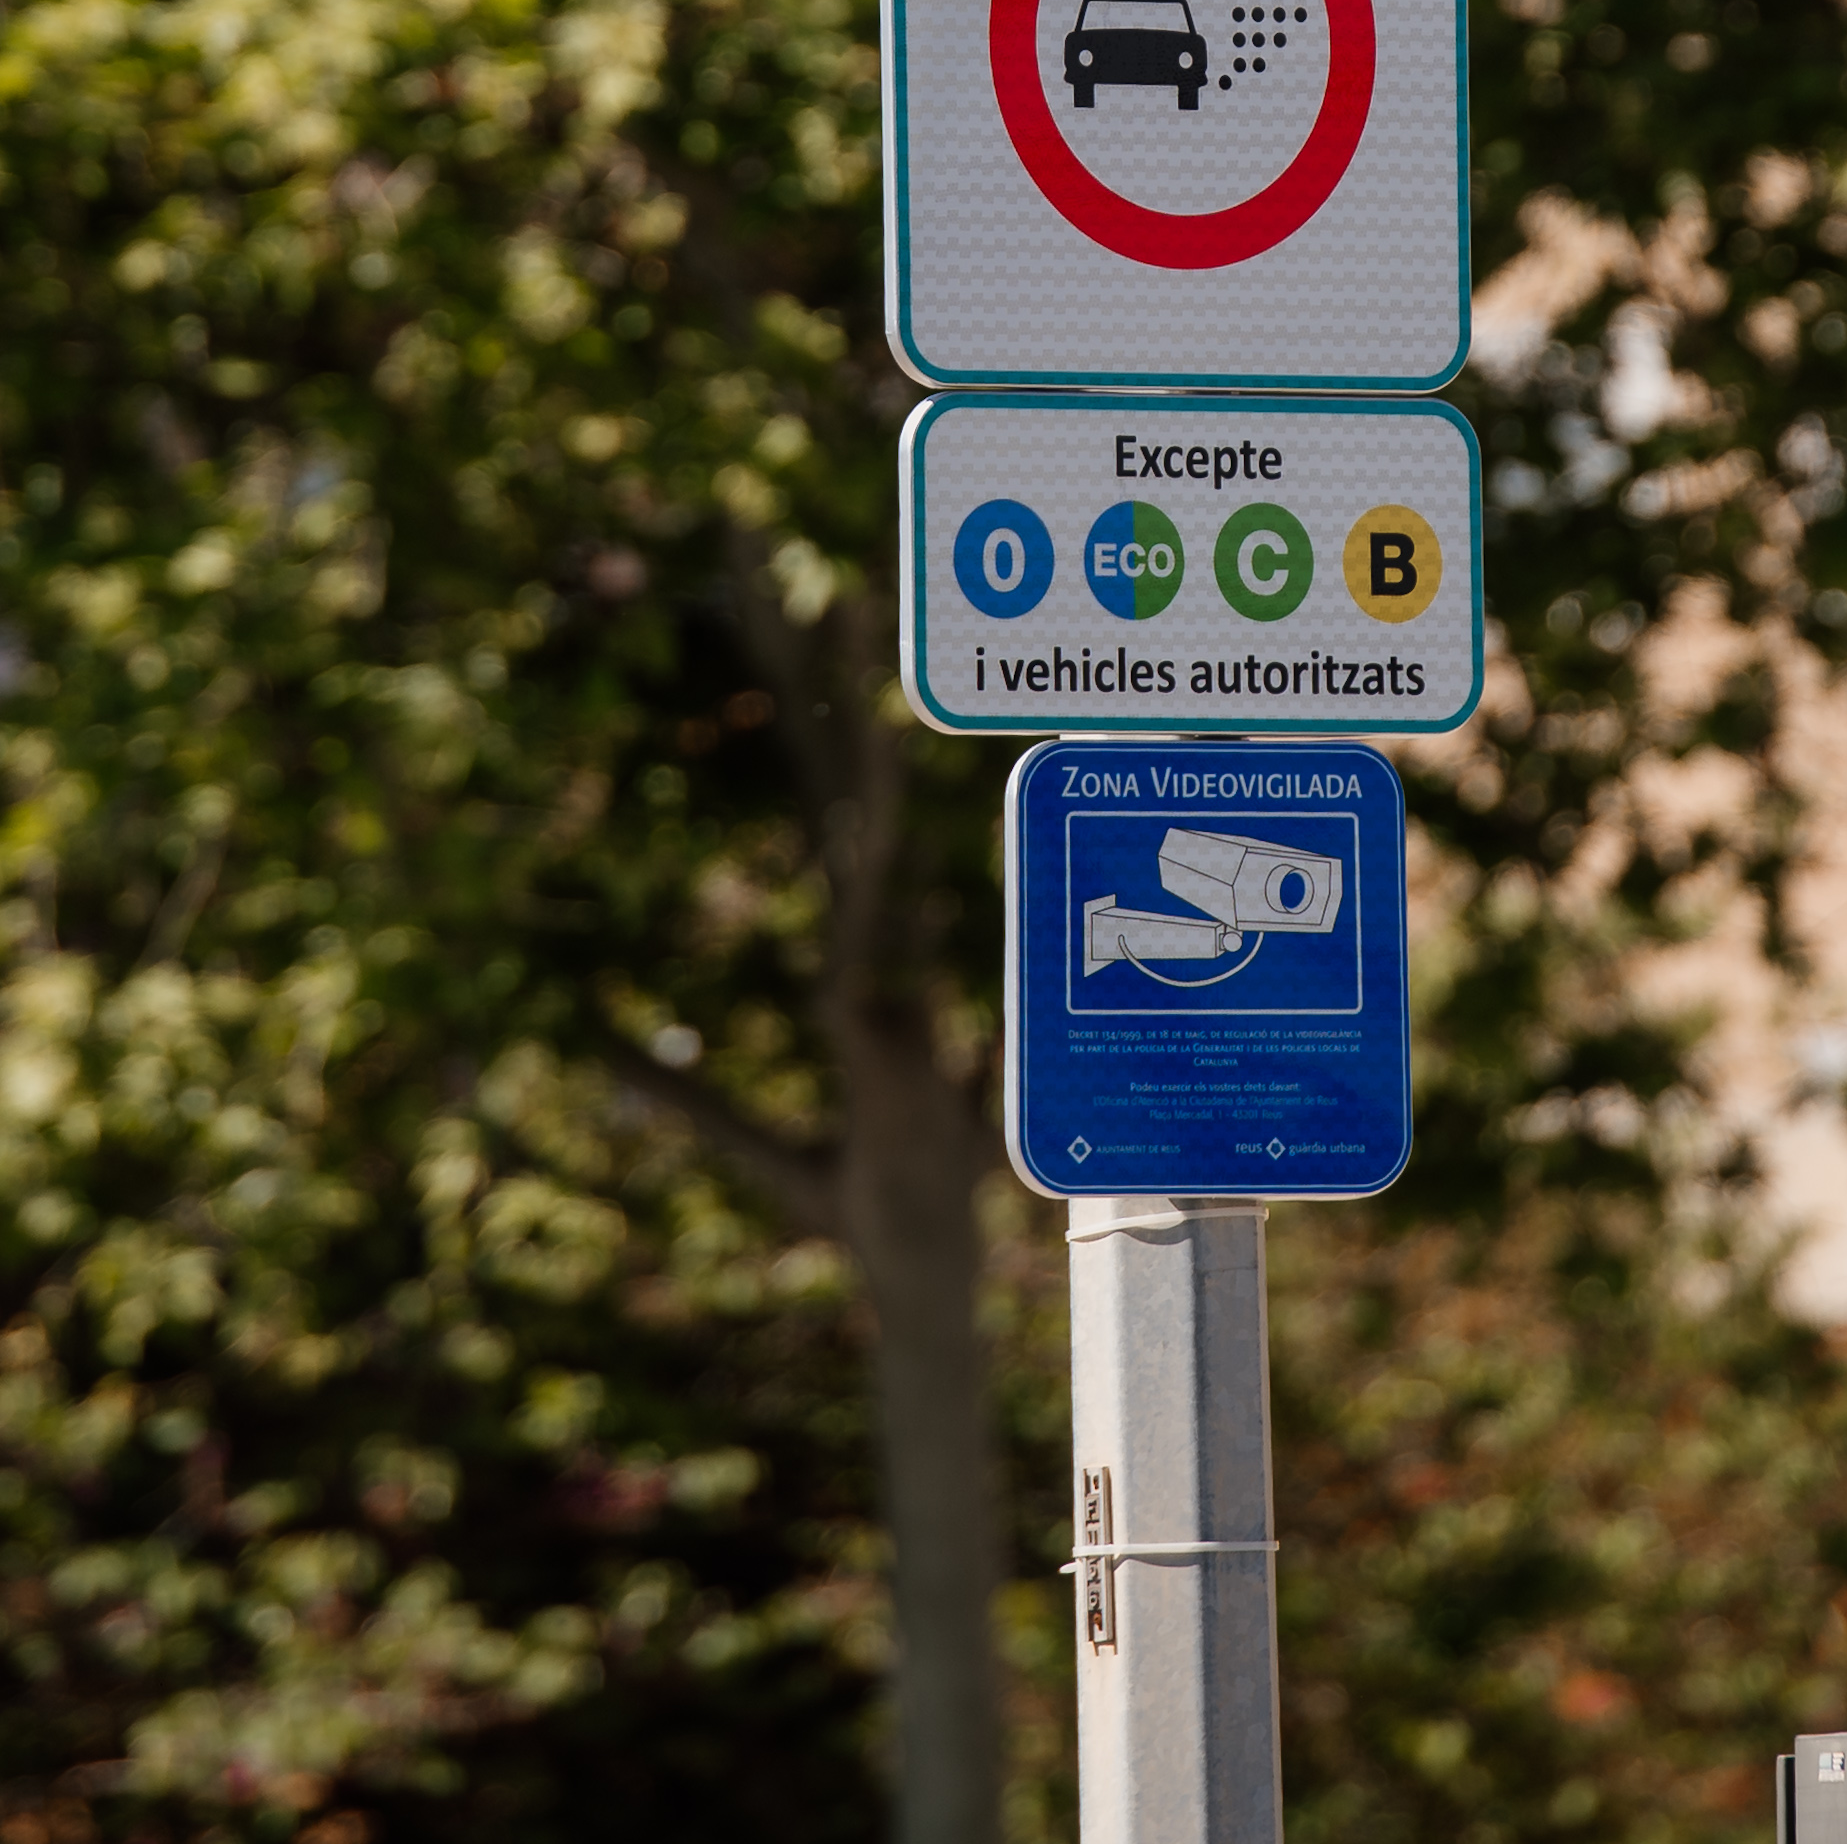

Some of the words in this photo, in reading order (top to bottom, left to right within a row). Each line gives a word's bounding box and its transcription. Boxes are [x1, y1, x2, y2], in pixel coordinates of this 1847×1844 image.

[1115, 434, 1283, 489] Excepte
[1093, 542, 1176, 579] ECO
[1237, 529, 1290, 596] C
[1370, 532, 1418, 597] B
[976, 647, 985, 691] i
[1000, 647, 1176, 694] vehicles
[1191, 651, 1426, 697] autoritzats
[1130, 1081, 1159, 1092] Podeu
[1161, 1081, 1192, 1092] exercir
[1194, 1081, 1207, 1092] els
[1209, 1083, 1241, 1092] vostres
[1243, 1080, 1266, 1092] drets
[1096, 1145, 1146, 1154] AJUNTAMENT
[1235, 1143, 1263, 1154] reus
[1330, 1141, 1366, 1154] urbana
